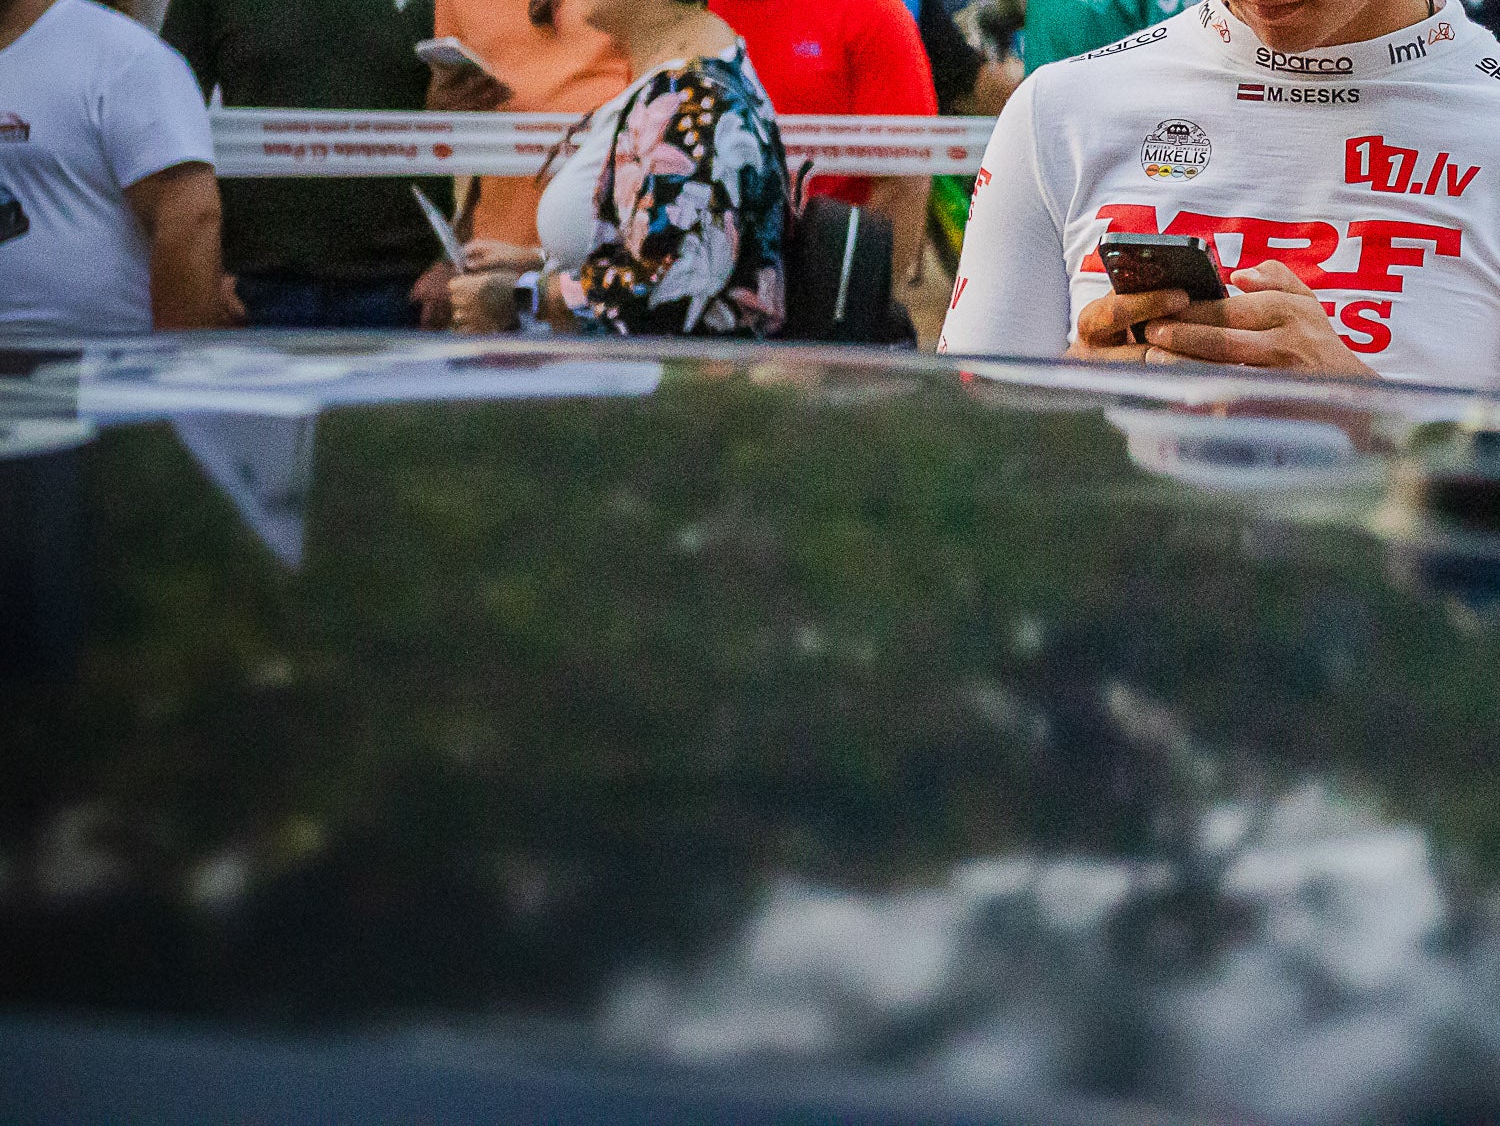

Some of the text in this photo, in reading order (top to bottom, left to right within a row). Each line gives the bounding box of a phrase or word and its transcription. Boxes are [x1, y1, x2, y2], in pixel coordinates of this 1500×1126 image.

[1256, 46, 1354, 74] sparco
[1388, 35, 1428, 65] lmt
[1267, 86, 1360, 104] M.SESKS
